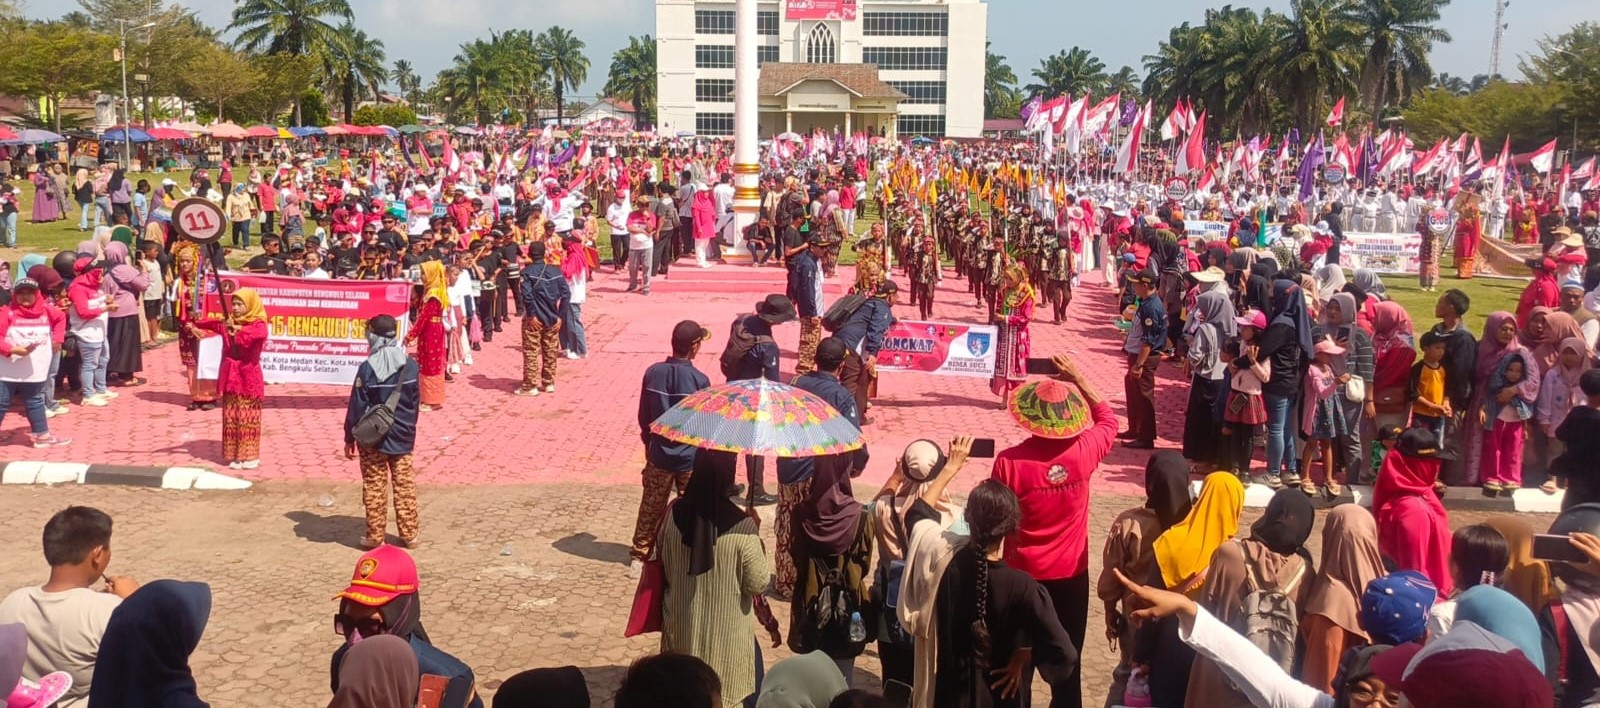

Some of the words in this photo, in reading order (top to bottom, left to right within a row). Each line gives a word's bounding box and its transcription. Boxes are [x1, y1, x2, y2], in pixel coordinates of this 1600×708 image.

[185, 211, 214, 231] 11
[270, 316, 284, 336] 15
[287, 316, 350, 339] BENGKULU
[279, 363, 312, 373] Bengkulu
[313, 365, 339, 373] Selatan
[290, 357, 313, 365] Medan
